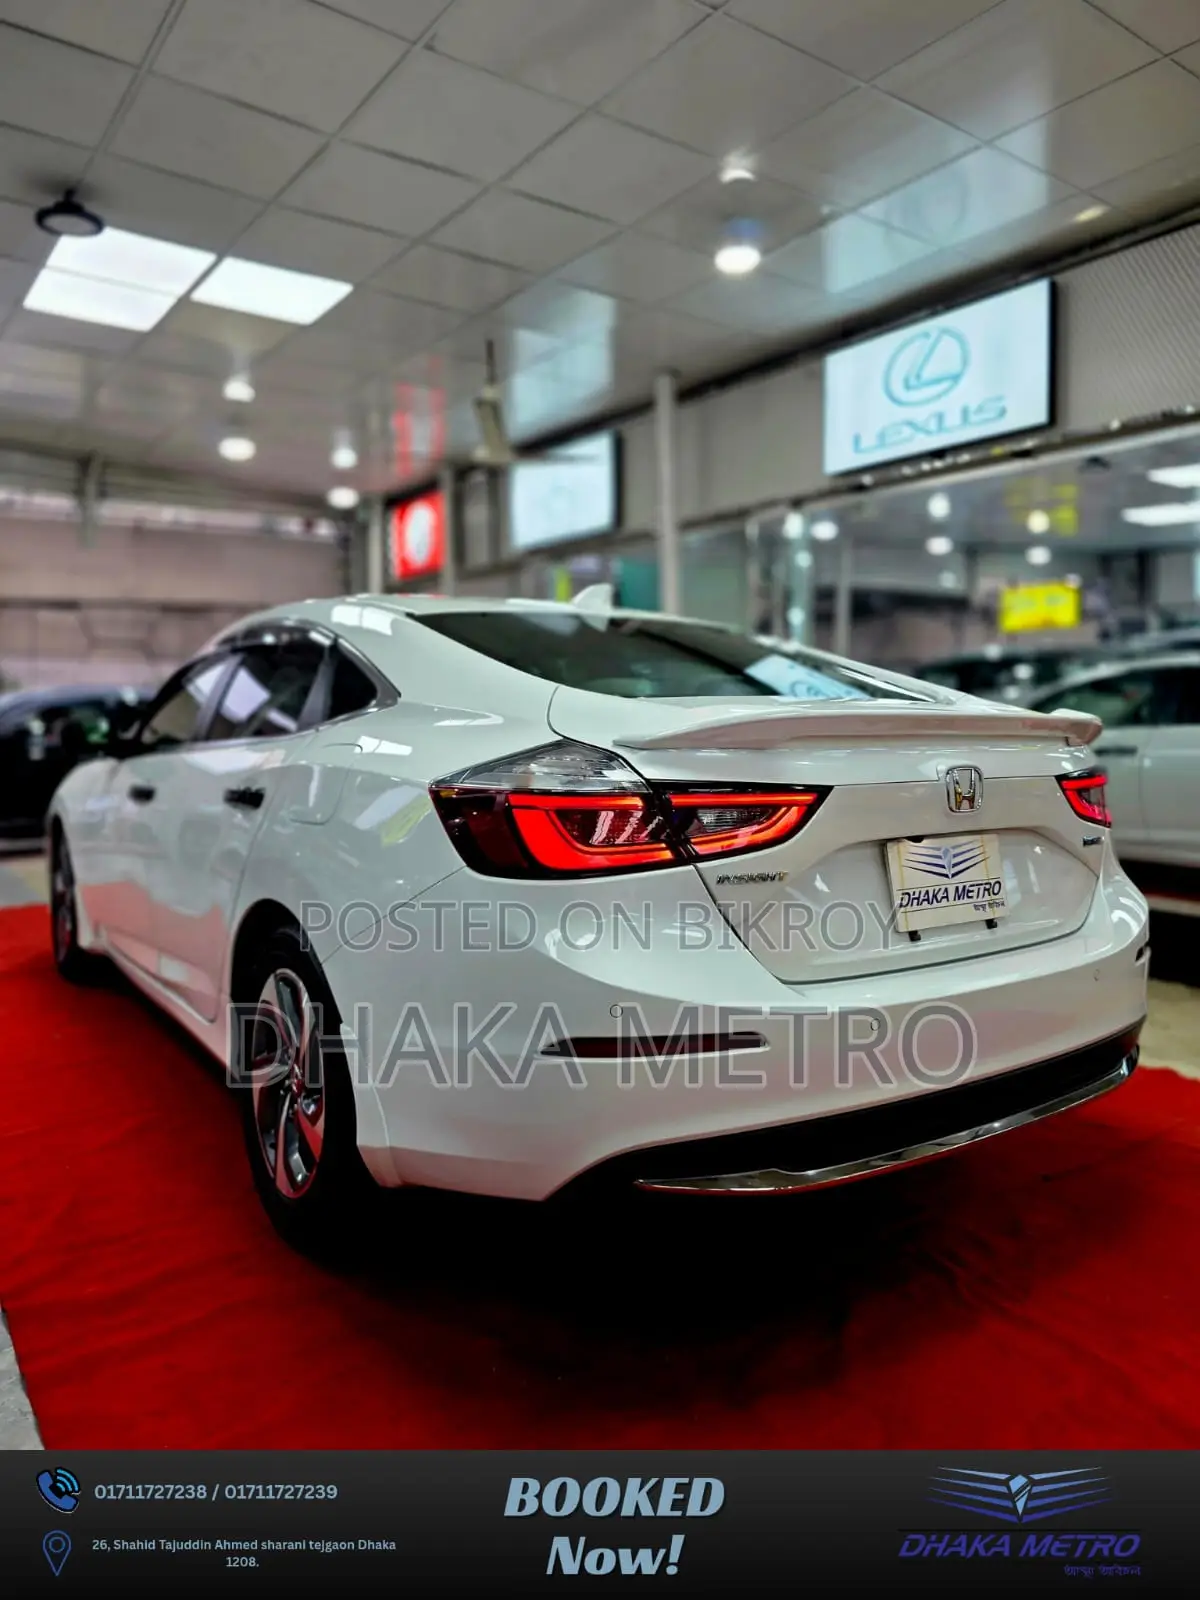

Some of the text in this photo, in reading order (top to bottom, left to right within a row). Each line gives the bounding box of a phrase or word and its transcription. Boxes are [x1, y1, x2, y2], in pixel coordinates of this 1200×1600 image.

[852, 395, 1008, 455] LEXUS
[898, 886, 950, 909] DHAKA
[953, 879, 1003, 902] METRO
